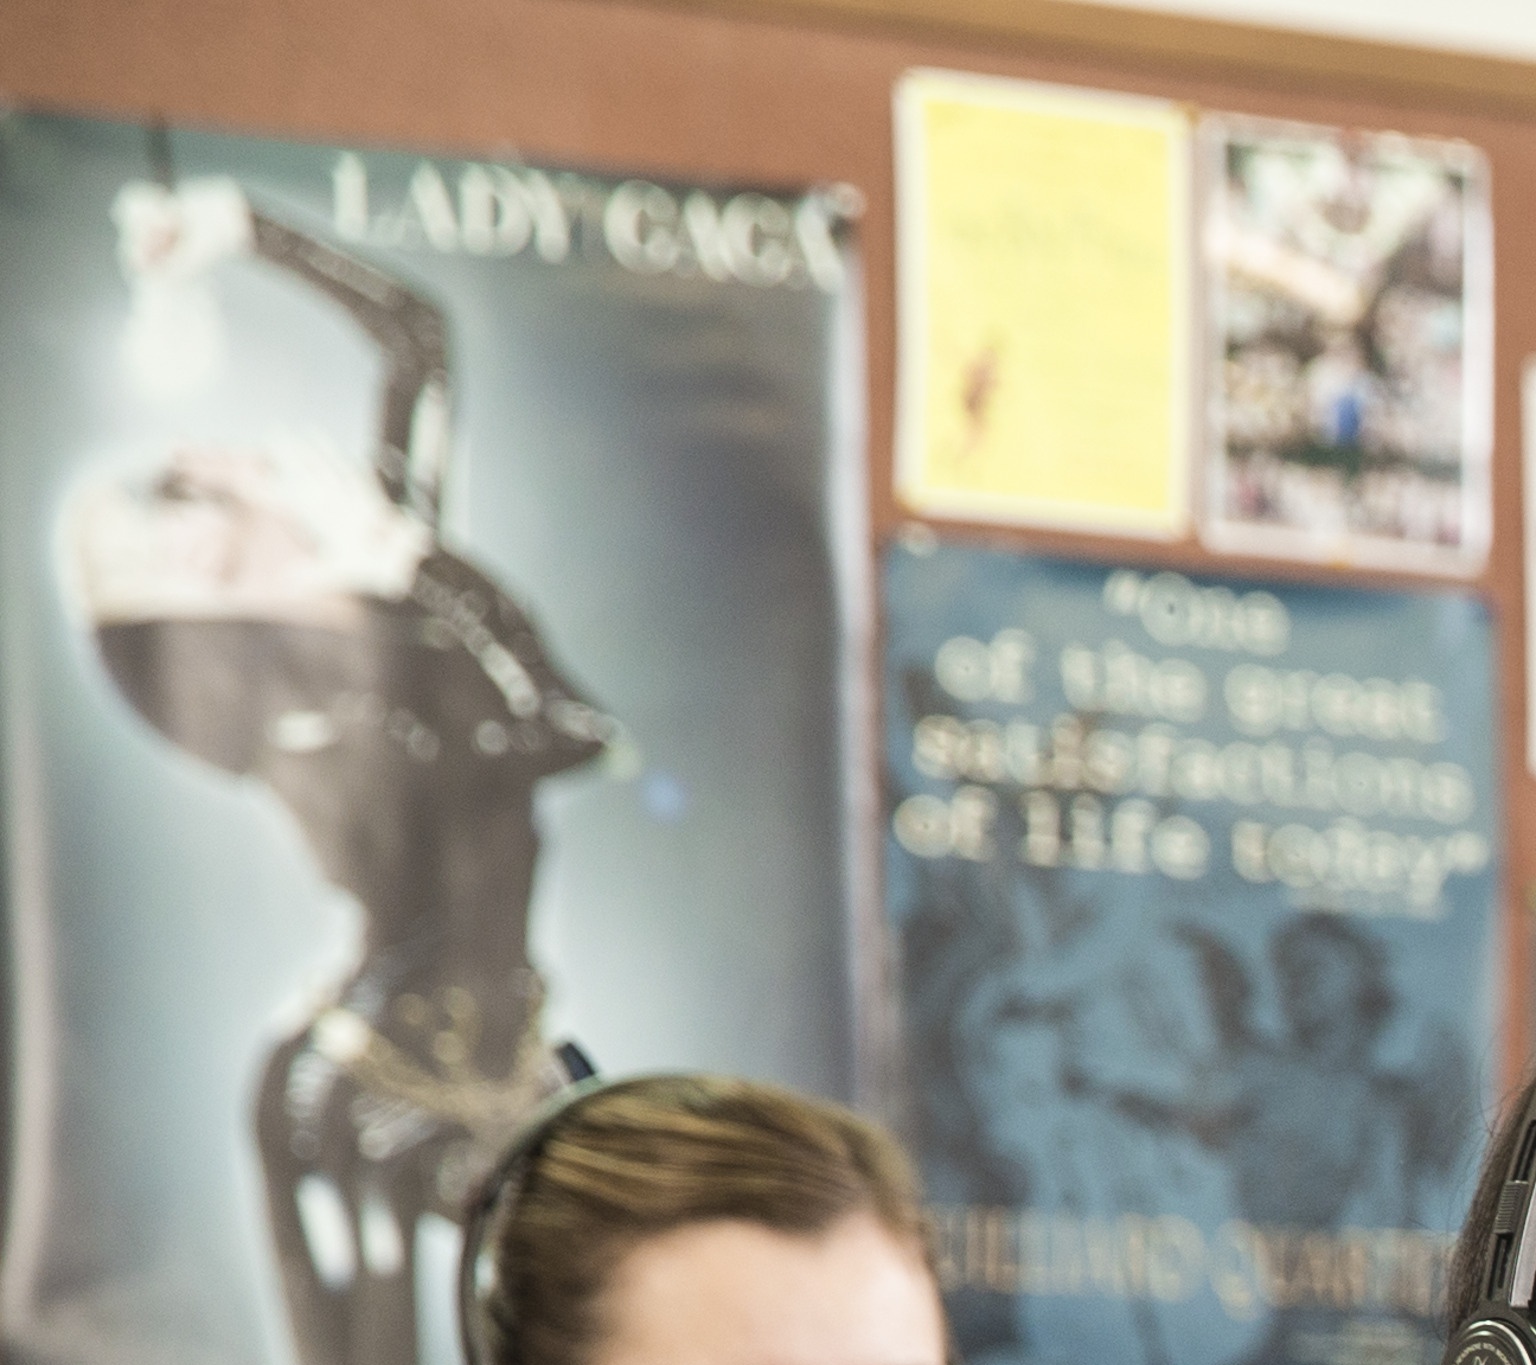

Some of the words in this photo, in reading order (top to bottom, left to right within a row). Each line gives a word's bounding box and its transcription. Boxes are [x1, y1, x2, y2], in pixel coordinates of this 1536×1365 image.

[330, 150, 572, 265] LADY
[601, 178, 852, 292] GAGA
[933, 628, 1033, 704] of
[1060, 639, 1206, 722] the
[1224, 660, 1446, 744] great
[910, 713, 1474, 825] satisfactions
[892, 784, 998, 862] of
[1024, 791, 1212, 882] life
